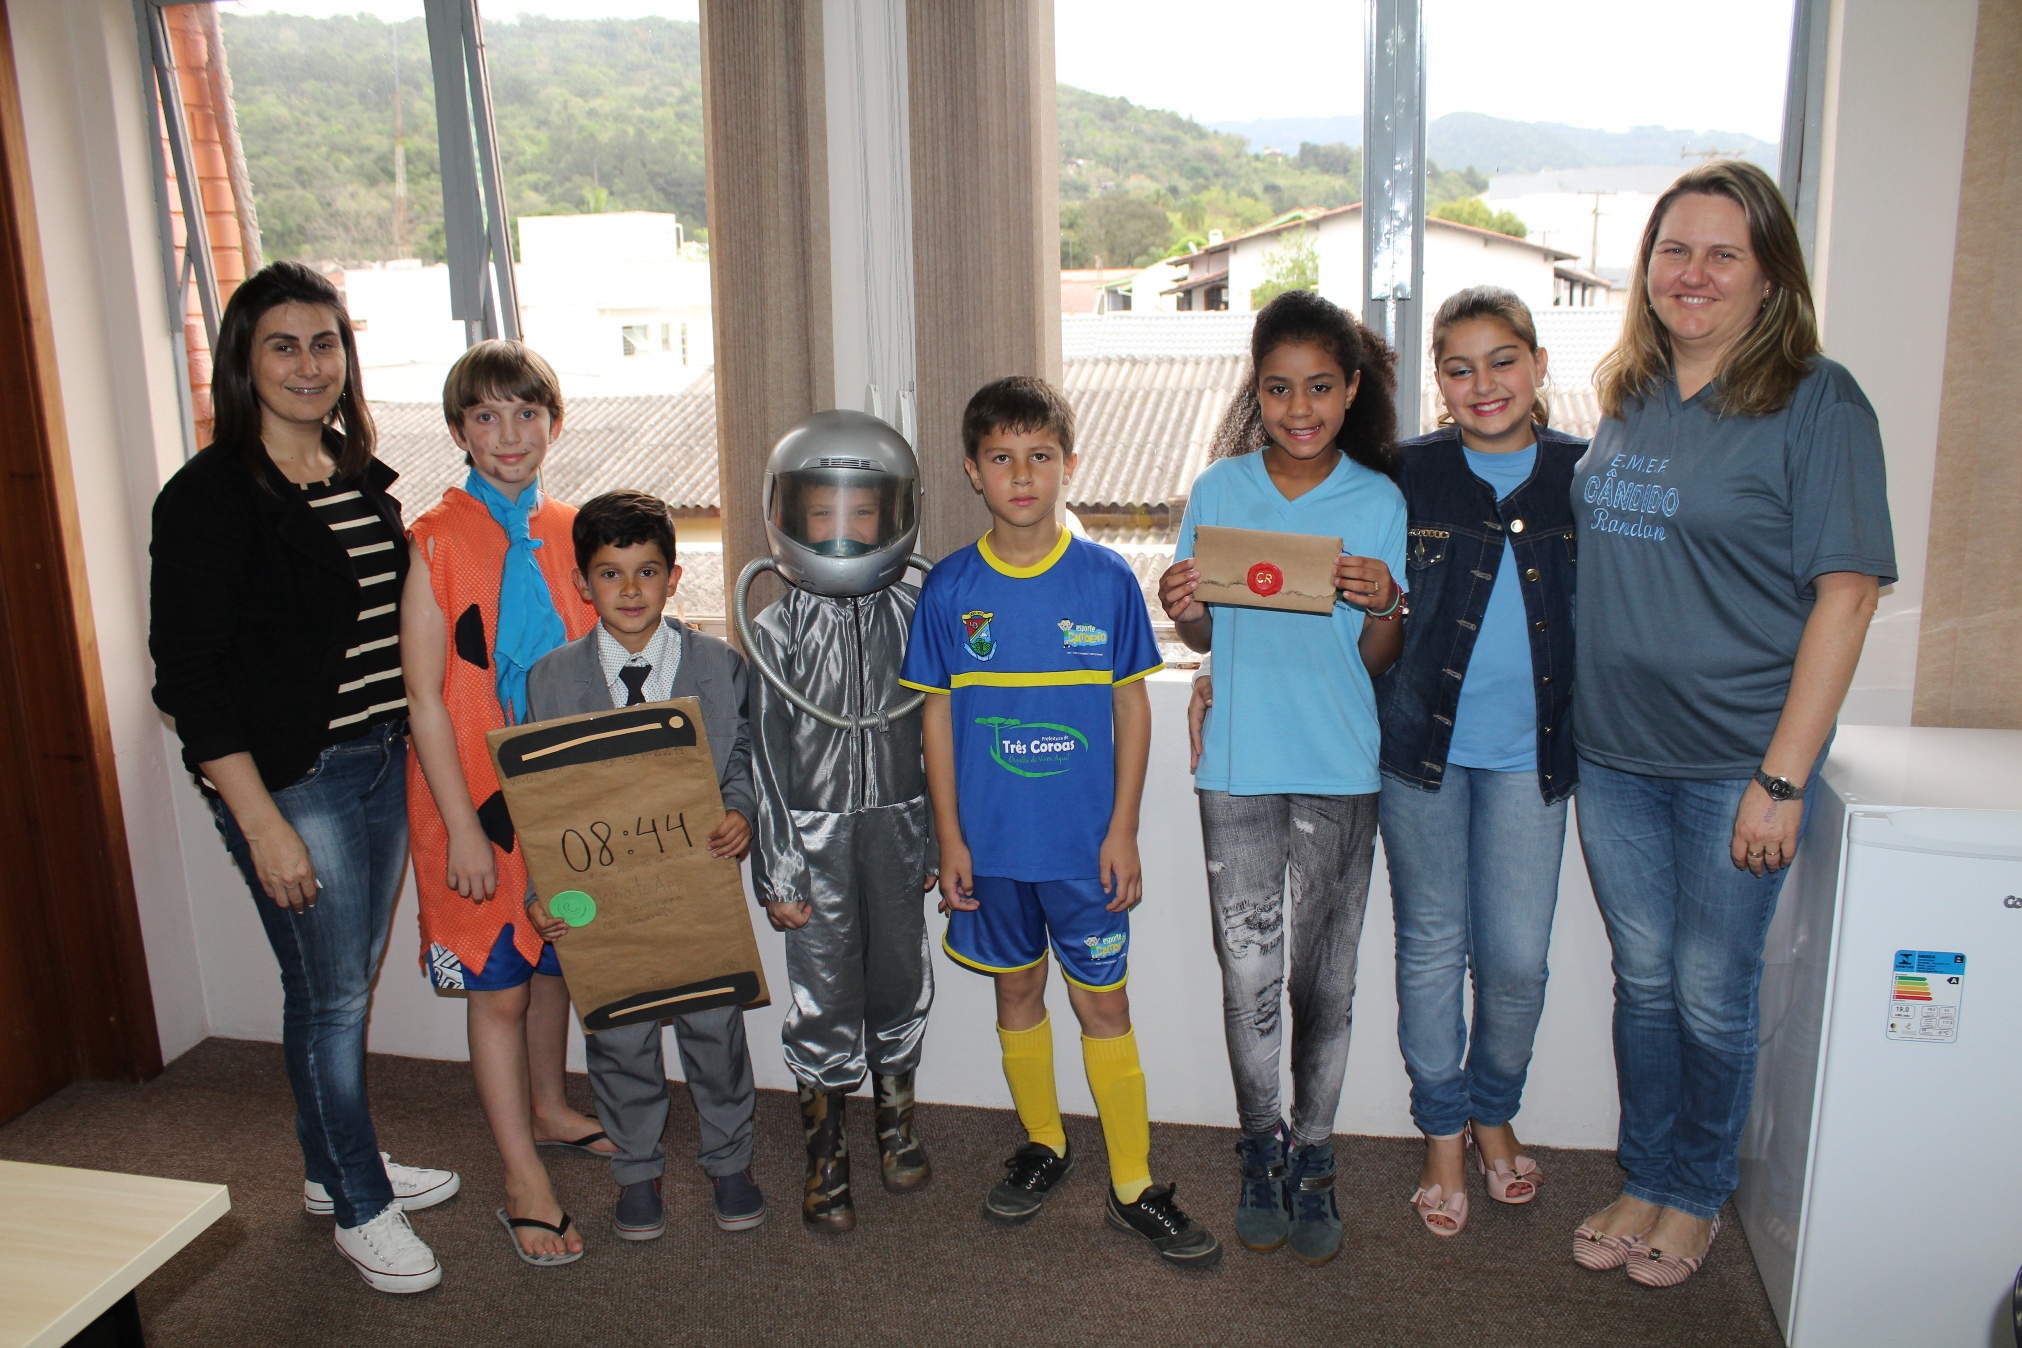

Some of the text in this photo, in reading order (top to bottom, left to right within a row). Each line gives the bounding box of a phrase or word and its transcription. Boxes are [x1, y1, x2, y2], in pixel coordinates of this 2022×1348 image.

[1584, 468, 1680, 517] CÂNDIDO
[1256, 572, 1273, 584] CR
[1075, 624, 1096, 633] esporte
[1002, 739, 1075, 755] Três Coroas
[561, 812, 693, 873] 08:44
